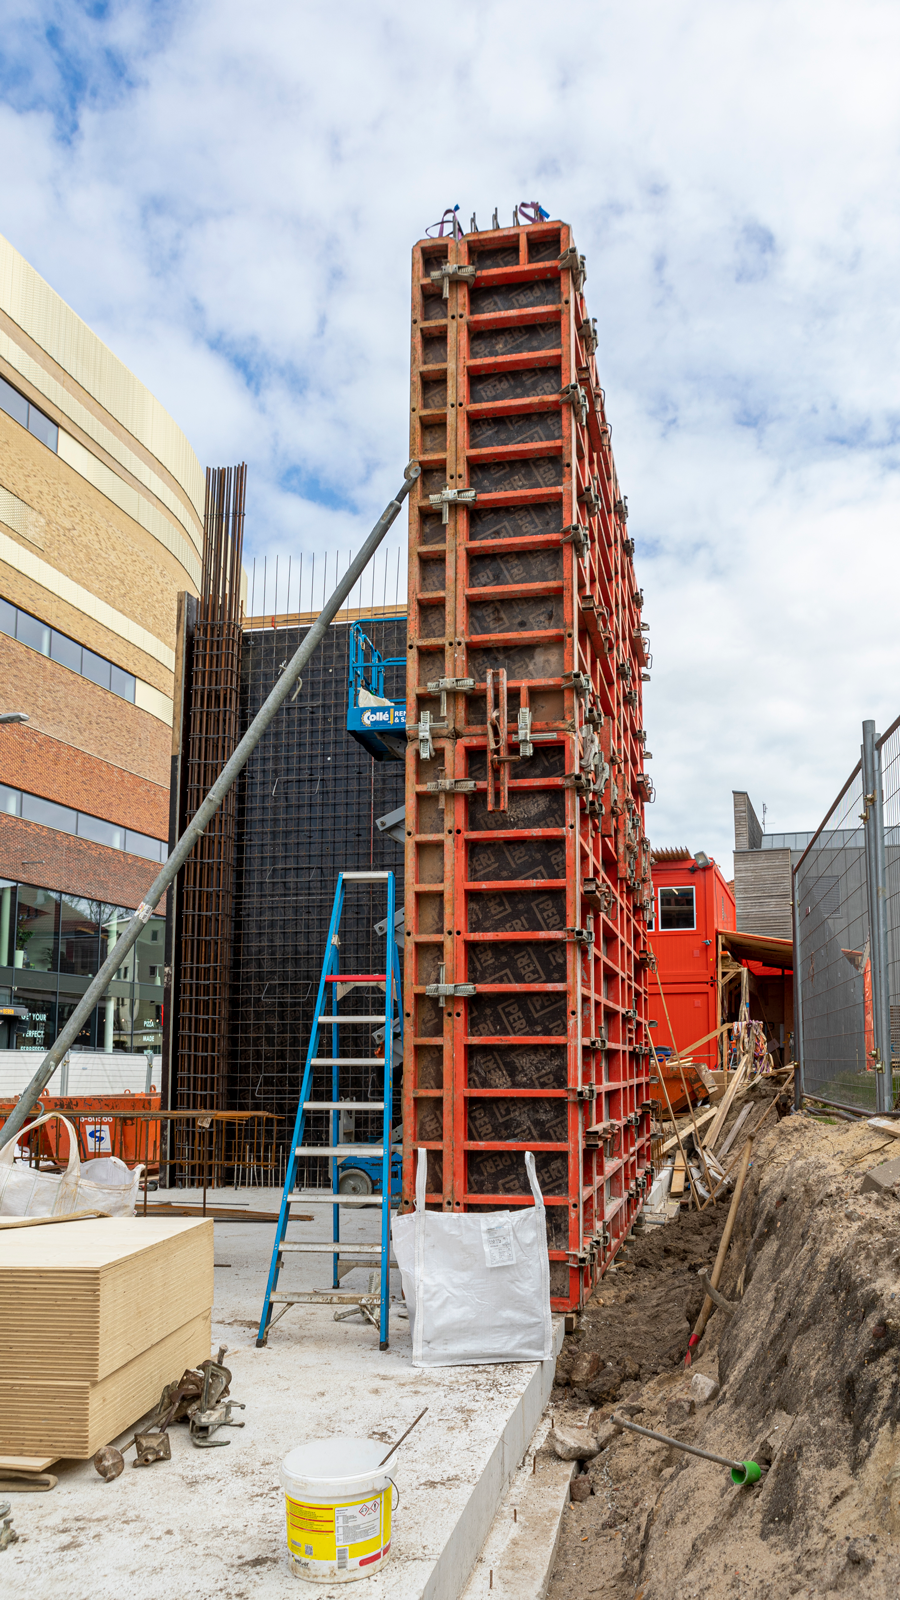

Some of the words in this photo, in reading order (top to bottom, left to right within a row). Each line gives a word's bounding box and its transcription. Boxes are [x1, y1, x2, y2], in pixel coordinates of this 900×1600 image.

[480, 377, 509, 401] PERI
[514, 507, 535, 533] PER
[362, 710, 389, 726] Collé
[480, 812, 504, 830] ERI
[532, 813, 563, 828] ERI
[538, 899, 564, 931] PERI
[475, 944, 495, 967] ERI
[513, 950, 539, 983] PERI
[32, 1013, 46, 1021] YOUR
[471, 1020, 496, 1036] ERI
[504, 1003, 530, 1035] PERI
[470, 1108, 496, 1140] PERI
[480, 1155, 511, 1176] PERI
